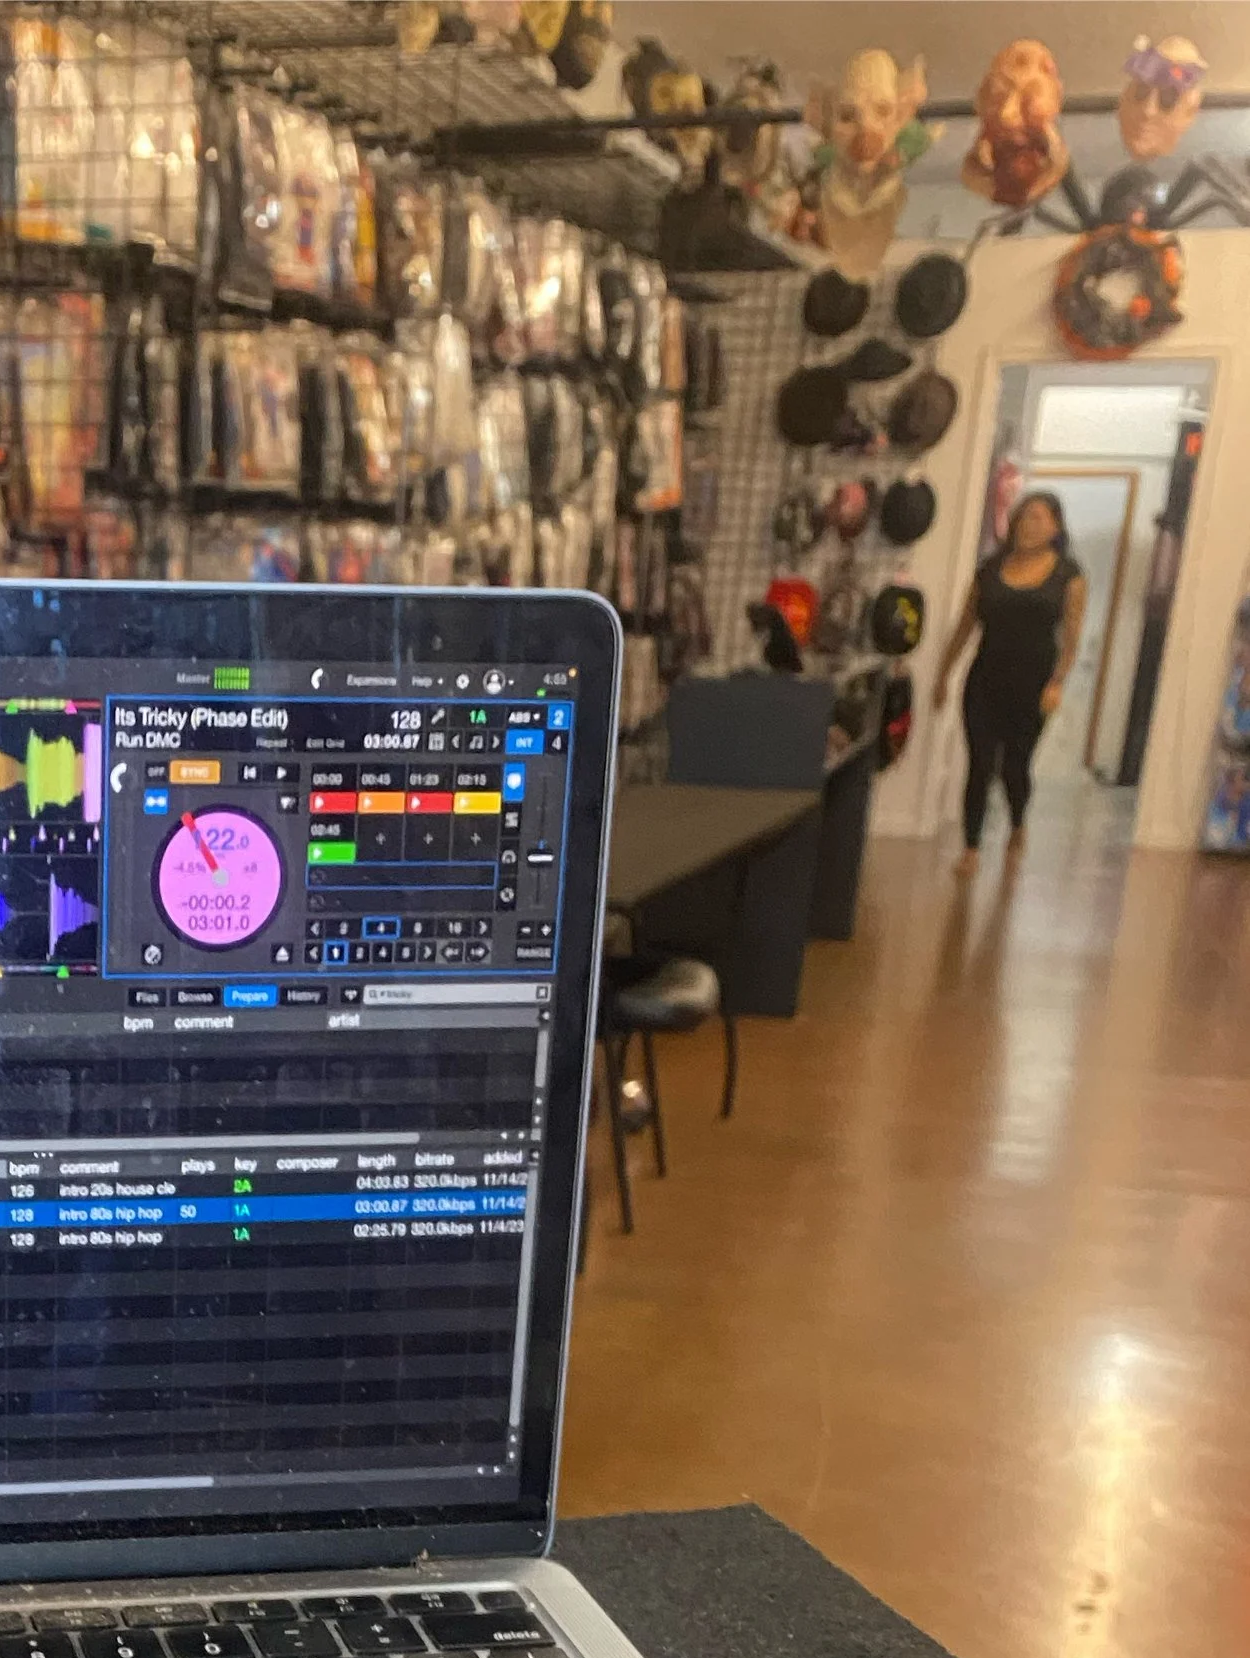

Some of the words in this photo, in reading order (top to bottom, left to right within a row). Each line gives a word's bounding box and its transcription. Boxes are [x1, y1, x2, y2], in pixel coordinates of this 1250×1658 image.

[115, 707, 135, 727] Its
[138, 707, 187, 730] Tricky
[192, 708, 247, 729] (Phase
[251, 708, 288, 730] Edit)
[391, 711, 421, 729] 128
[470, 710, 486, 723] 1A
[116, 733, 143, 748] Run
[146, 733, 180, 748] DMC
[182, 895, 249, 910] -00:00.2
[189, 916, 249, 930] 03:01.0
[232, 991, 268, 1003] Prepare
[124, 1015, 153, 1031] bpm
[175, 1016, 234, 1030] comment
[329, 1014, 360, 1028] artist
[234, 1158, 257, 1172] key
[277, 1157, 338, 1171] composer
[358, 1155, 396, 1169] length
[416, 1154, 454, 1166] bitrate
[484, 1151, 522, 1165] added
[9, 1163, 40, 1177] bpm
[60, 1161, 118, 1174] comment
[181, 1159, 215, 1174] plays
[116, 1208, 135, 1222] hip
[138, 1208, 162, 1222] hop
[180, 1206, 196, 1218] 50
[493, 1630, 539, 1642] delete
